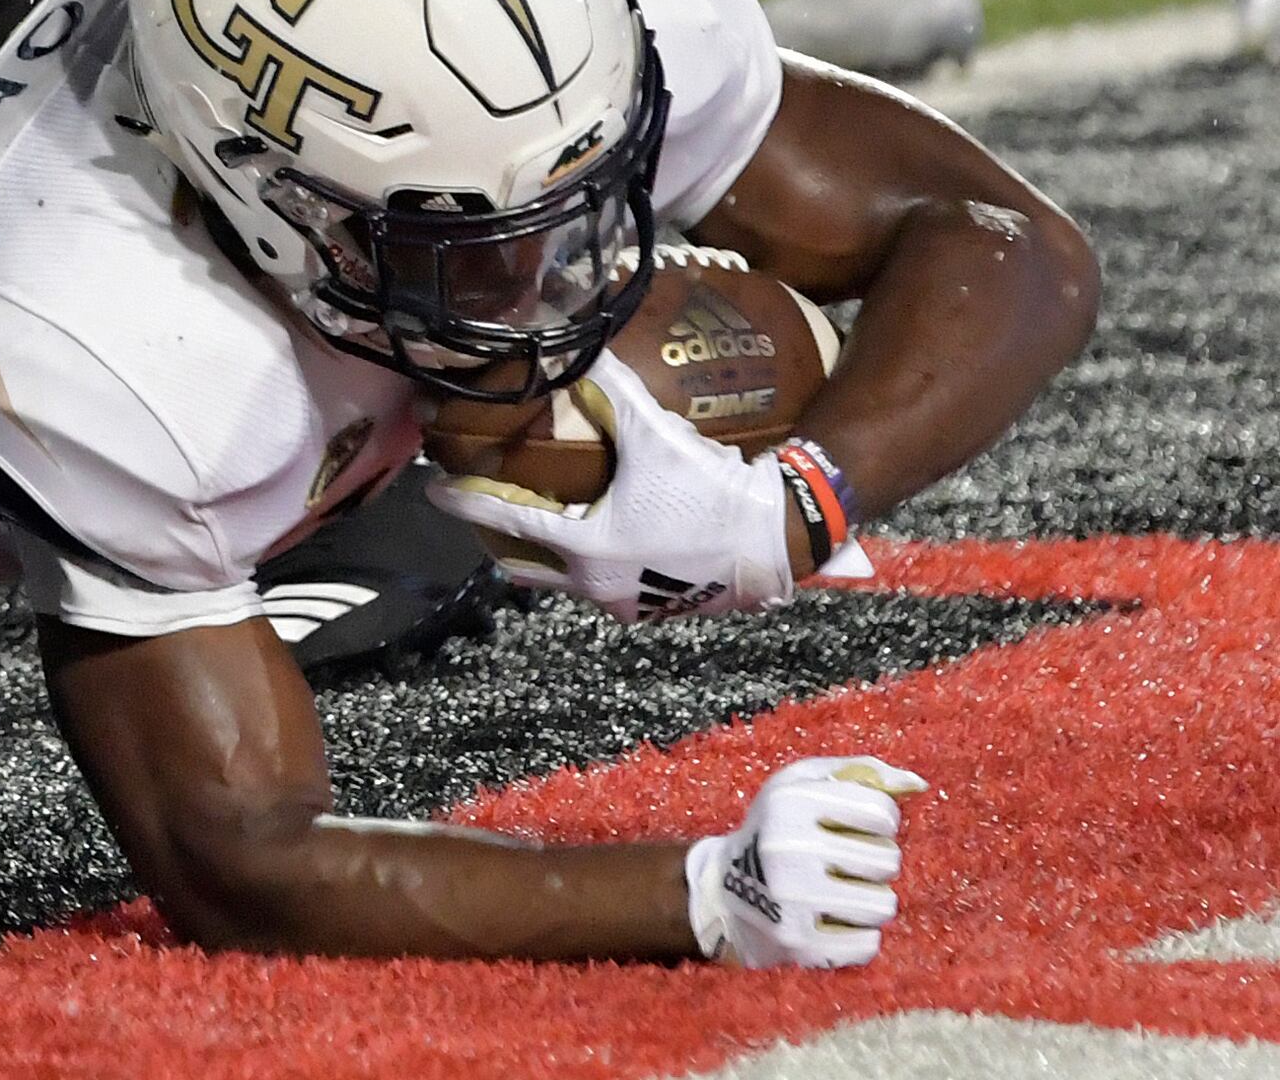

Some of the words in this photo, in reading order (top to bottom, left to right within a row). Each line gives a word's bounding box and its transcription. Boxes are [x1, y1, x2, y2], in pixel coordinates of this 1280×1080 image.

[547, 119, 604, 177] ACC
[661, 328, 777, 367] adidas
[686, 388, 776, 420] DIME
